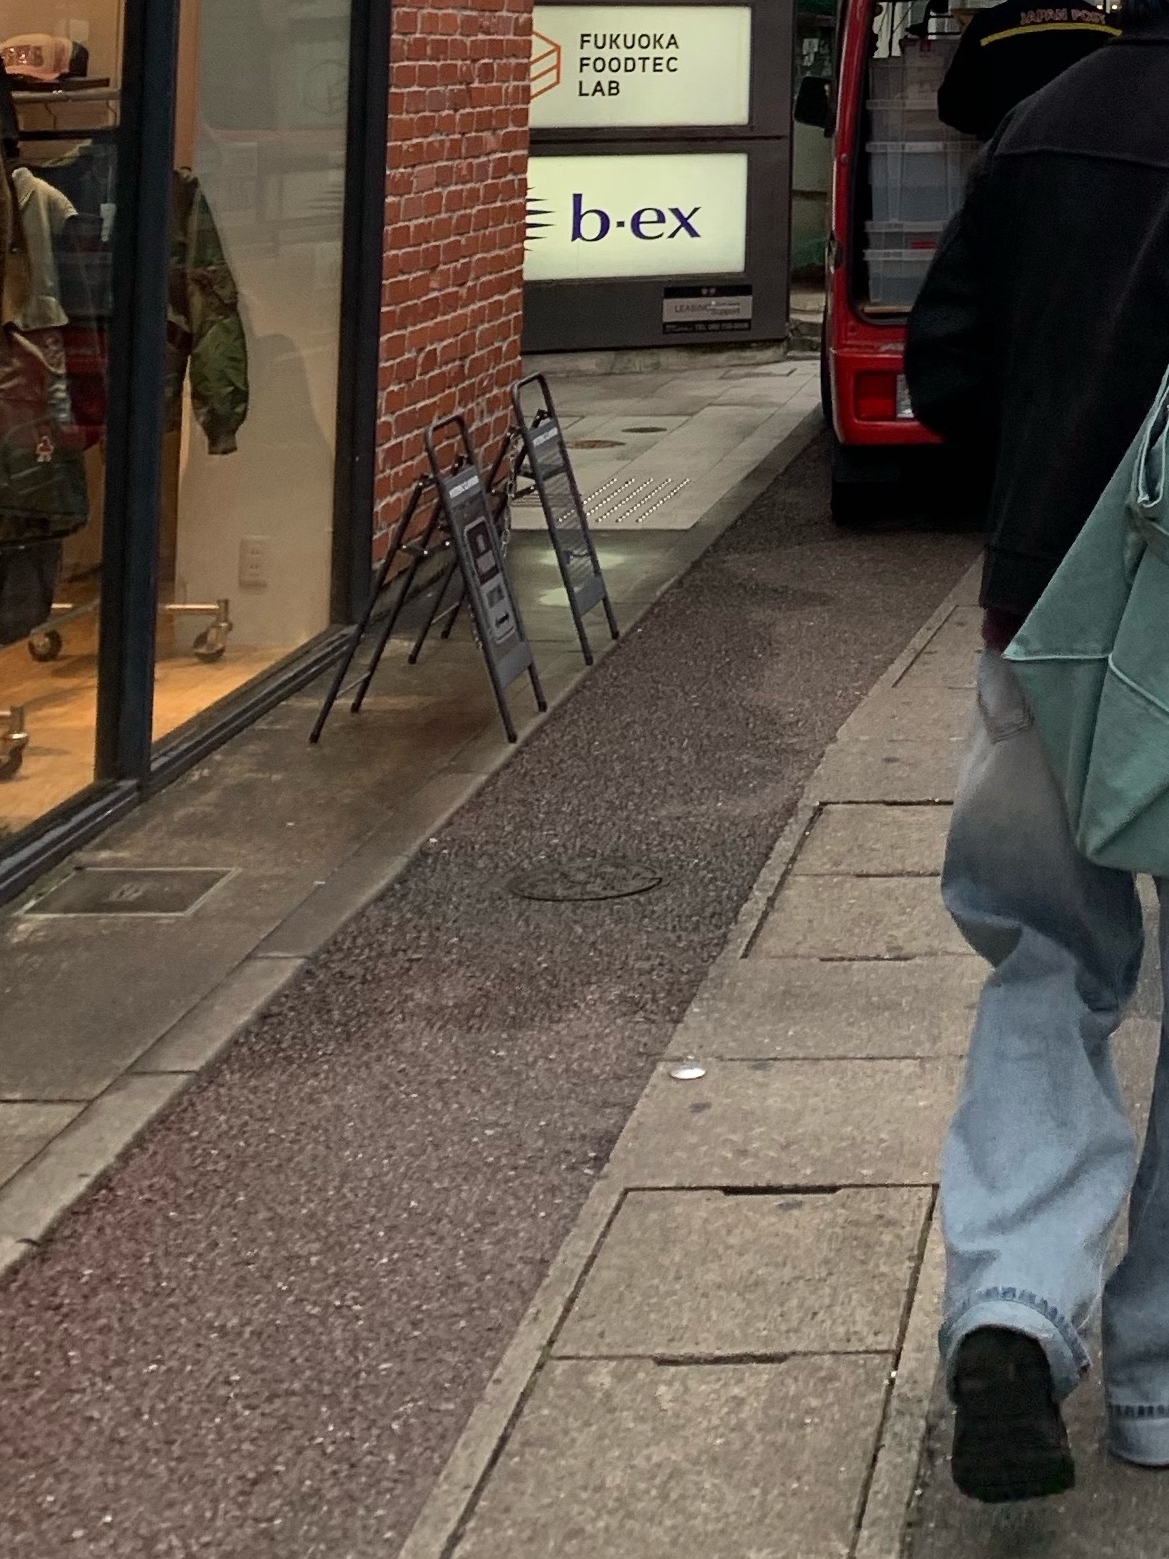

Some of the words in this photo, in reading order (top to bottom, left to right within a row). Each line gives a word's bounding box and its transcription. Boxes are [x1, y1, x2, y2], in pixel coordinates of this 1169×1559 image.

[579, 33, 680, 50] FUKUOKA
[579, 56, 679, 73] FOODTEC
[578, 80, 621, 97] LAB
